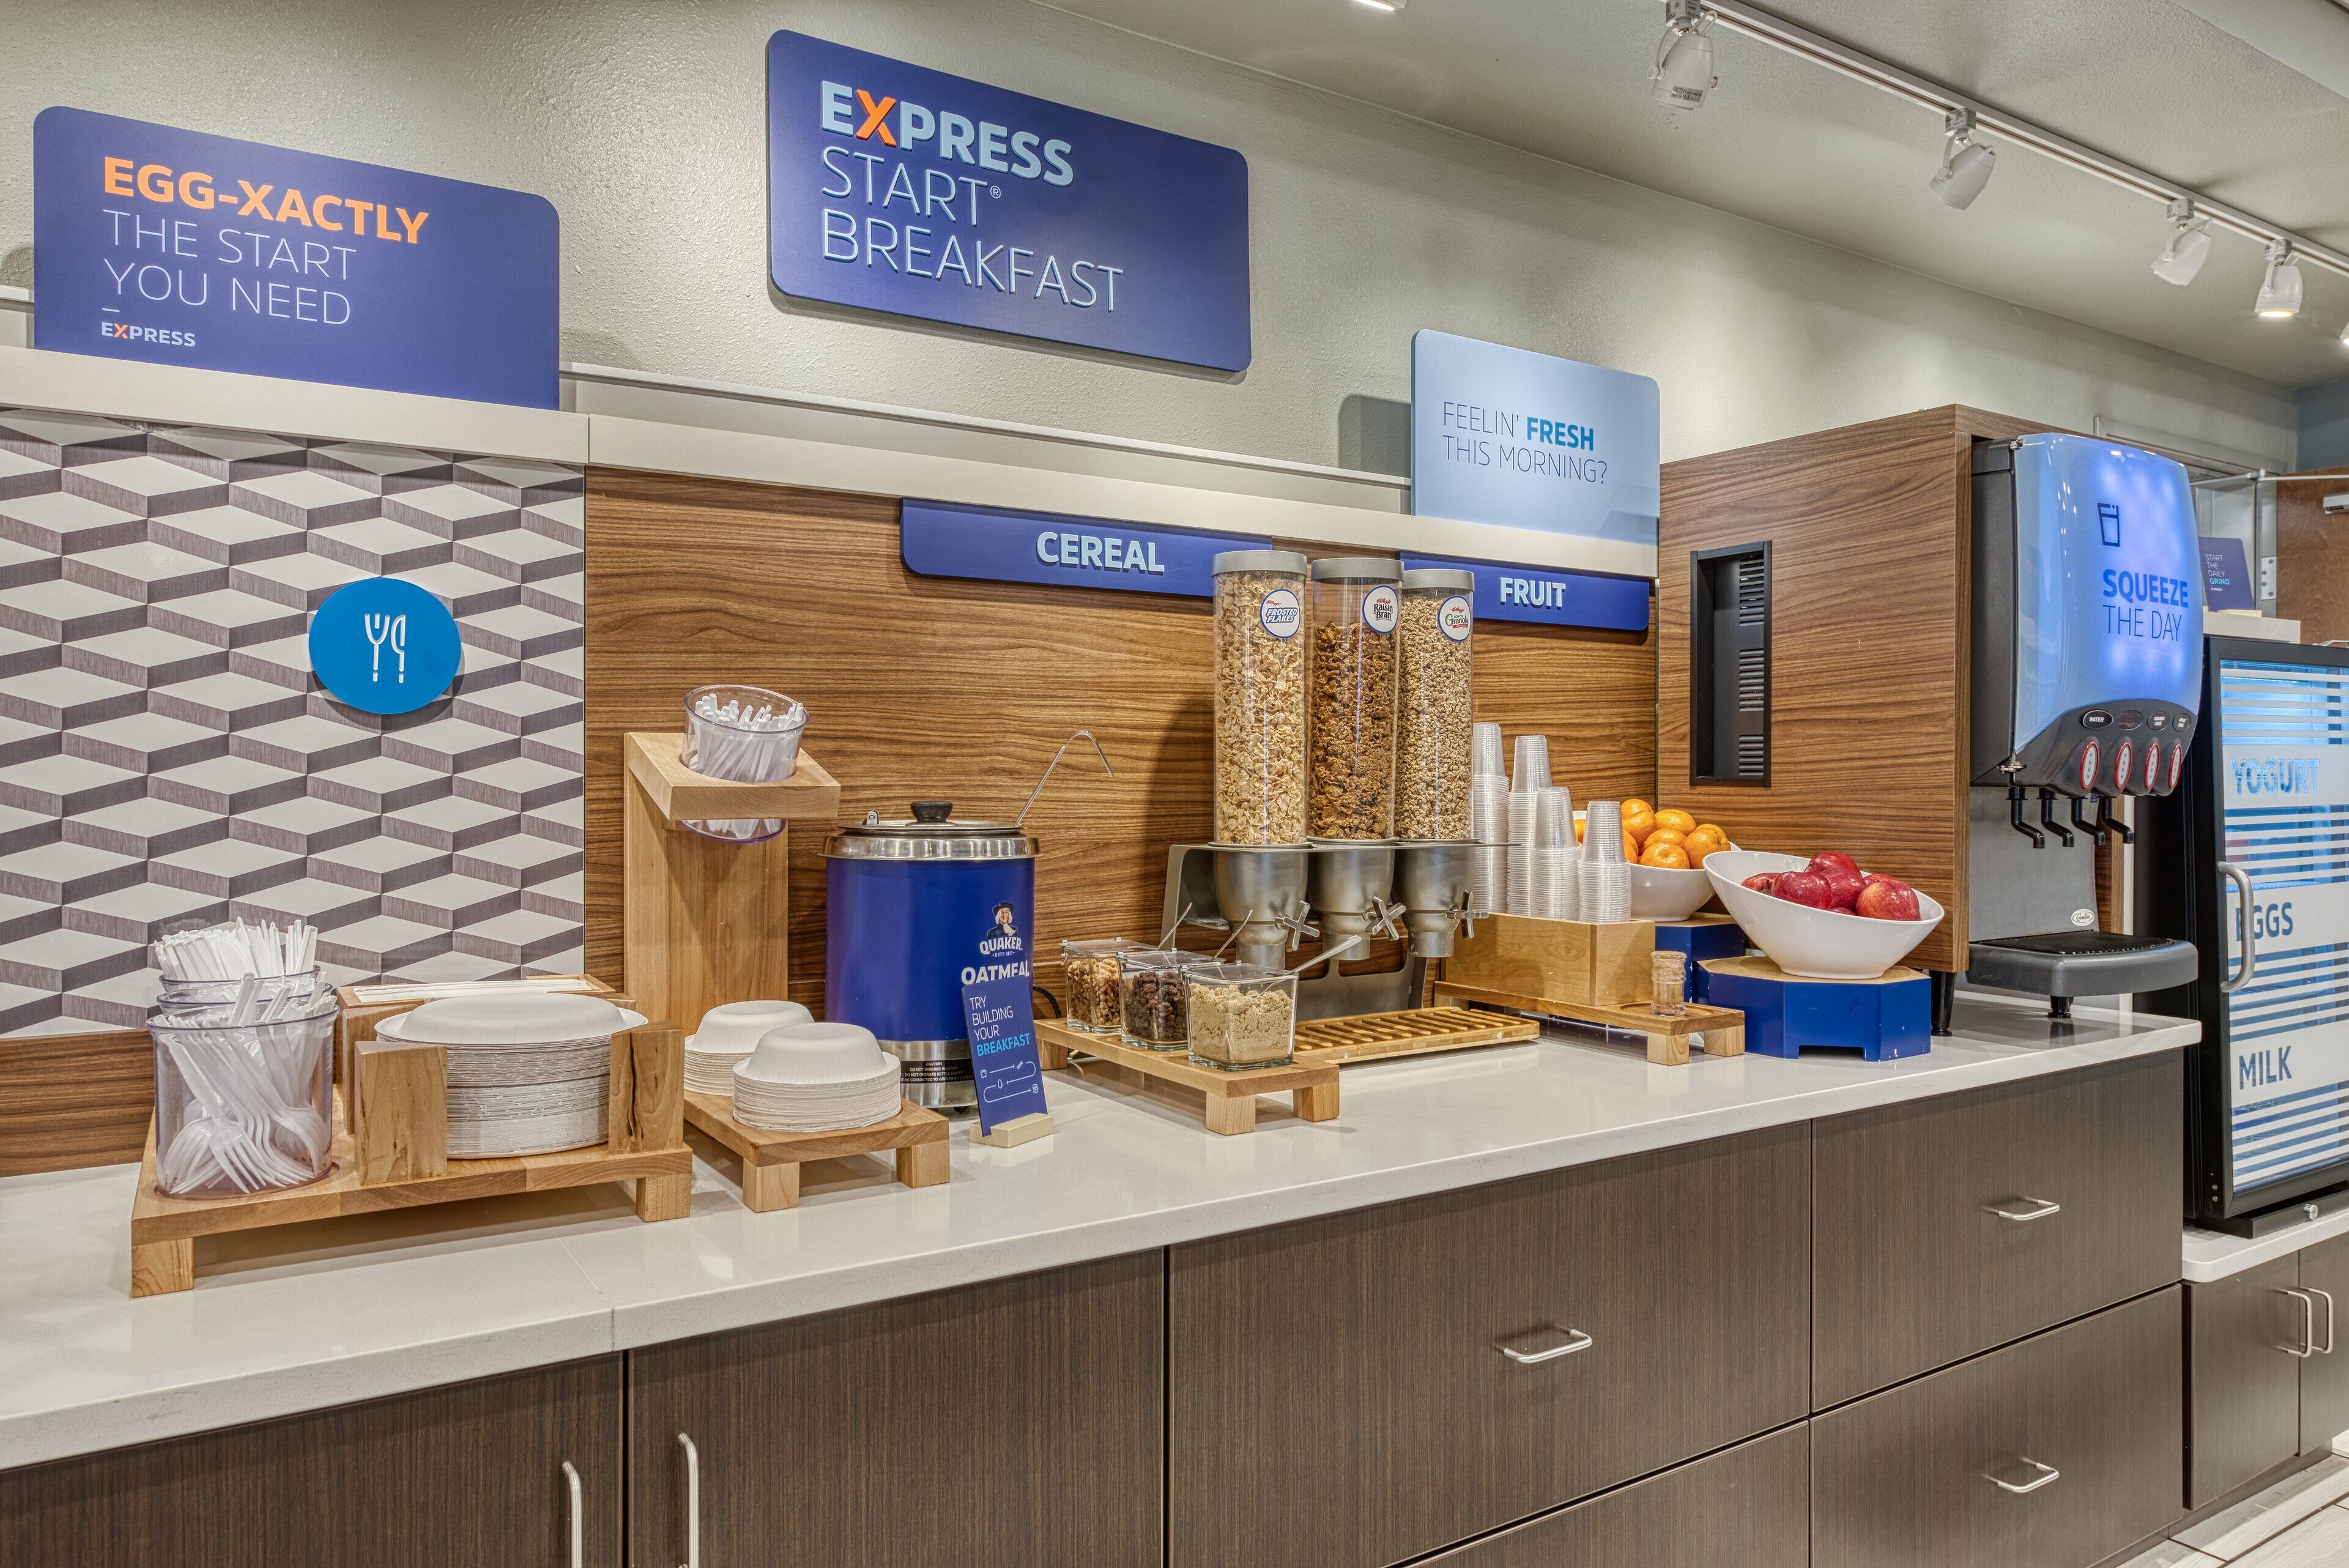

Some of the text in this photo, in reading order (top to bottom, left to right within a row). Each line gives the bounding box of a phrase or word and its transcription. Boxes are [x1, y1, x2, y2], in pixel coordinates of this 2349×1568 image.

[822, 80, 1074, 187] EXPRESS
[104, 156, 429, 244] EGG-XACTLY
[103, 209, 357, 280] THE START
[823, 208, 1124, 313] BREAKFAST
[103, 258, 351, 325] YOU NEED
[102, 321, 196, 348] EXPRESS
[1526, 416, 1594, 451] FRESH
[1442, 434, 1608, 485] THIS MORNING?
[1036, 531, 1165, 574] CEREAL
[1499, 577, 1566, 609] FRUIT
[2102, 568, 2189, 608] SQUEEZE
[1266, 608, 1297, 616] FROSTED
[1266, 615, 1294, 623] FLAKES
[1374, 603, 1393, 612] Raisin
[1376, 611, 1392, 620] Bran
[1445, 614, 1468, 626] Granola
[2102, 605, 2182, 641] THE DAY
[2230, 759, 2320, 795] YOGURT
[970, 995, 987, 1010] TRY
[973, 1006, 1014, 1026] BUILDING
[974, 1025, 1000, 1041] YOUR
[976, 1033, 1030, 1057] BREAKFAST
[2239, 1046, 2292, 1090] MILK
